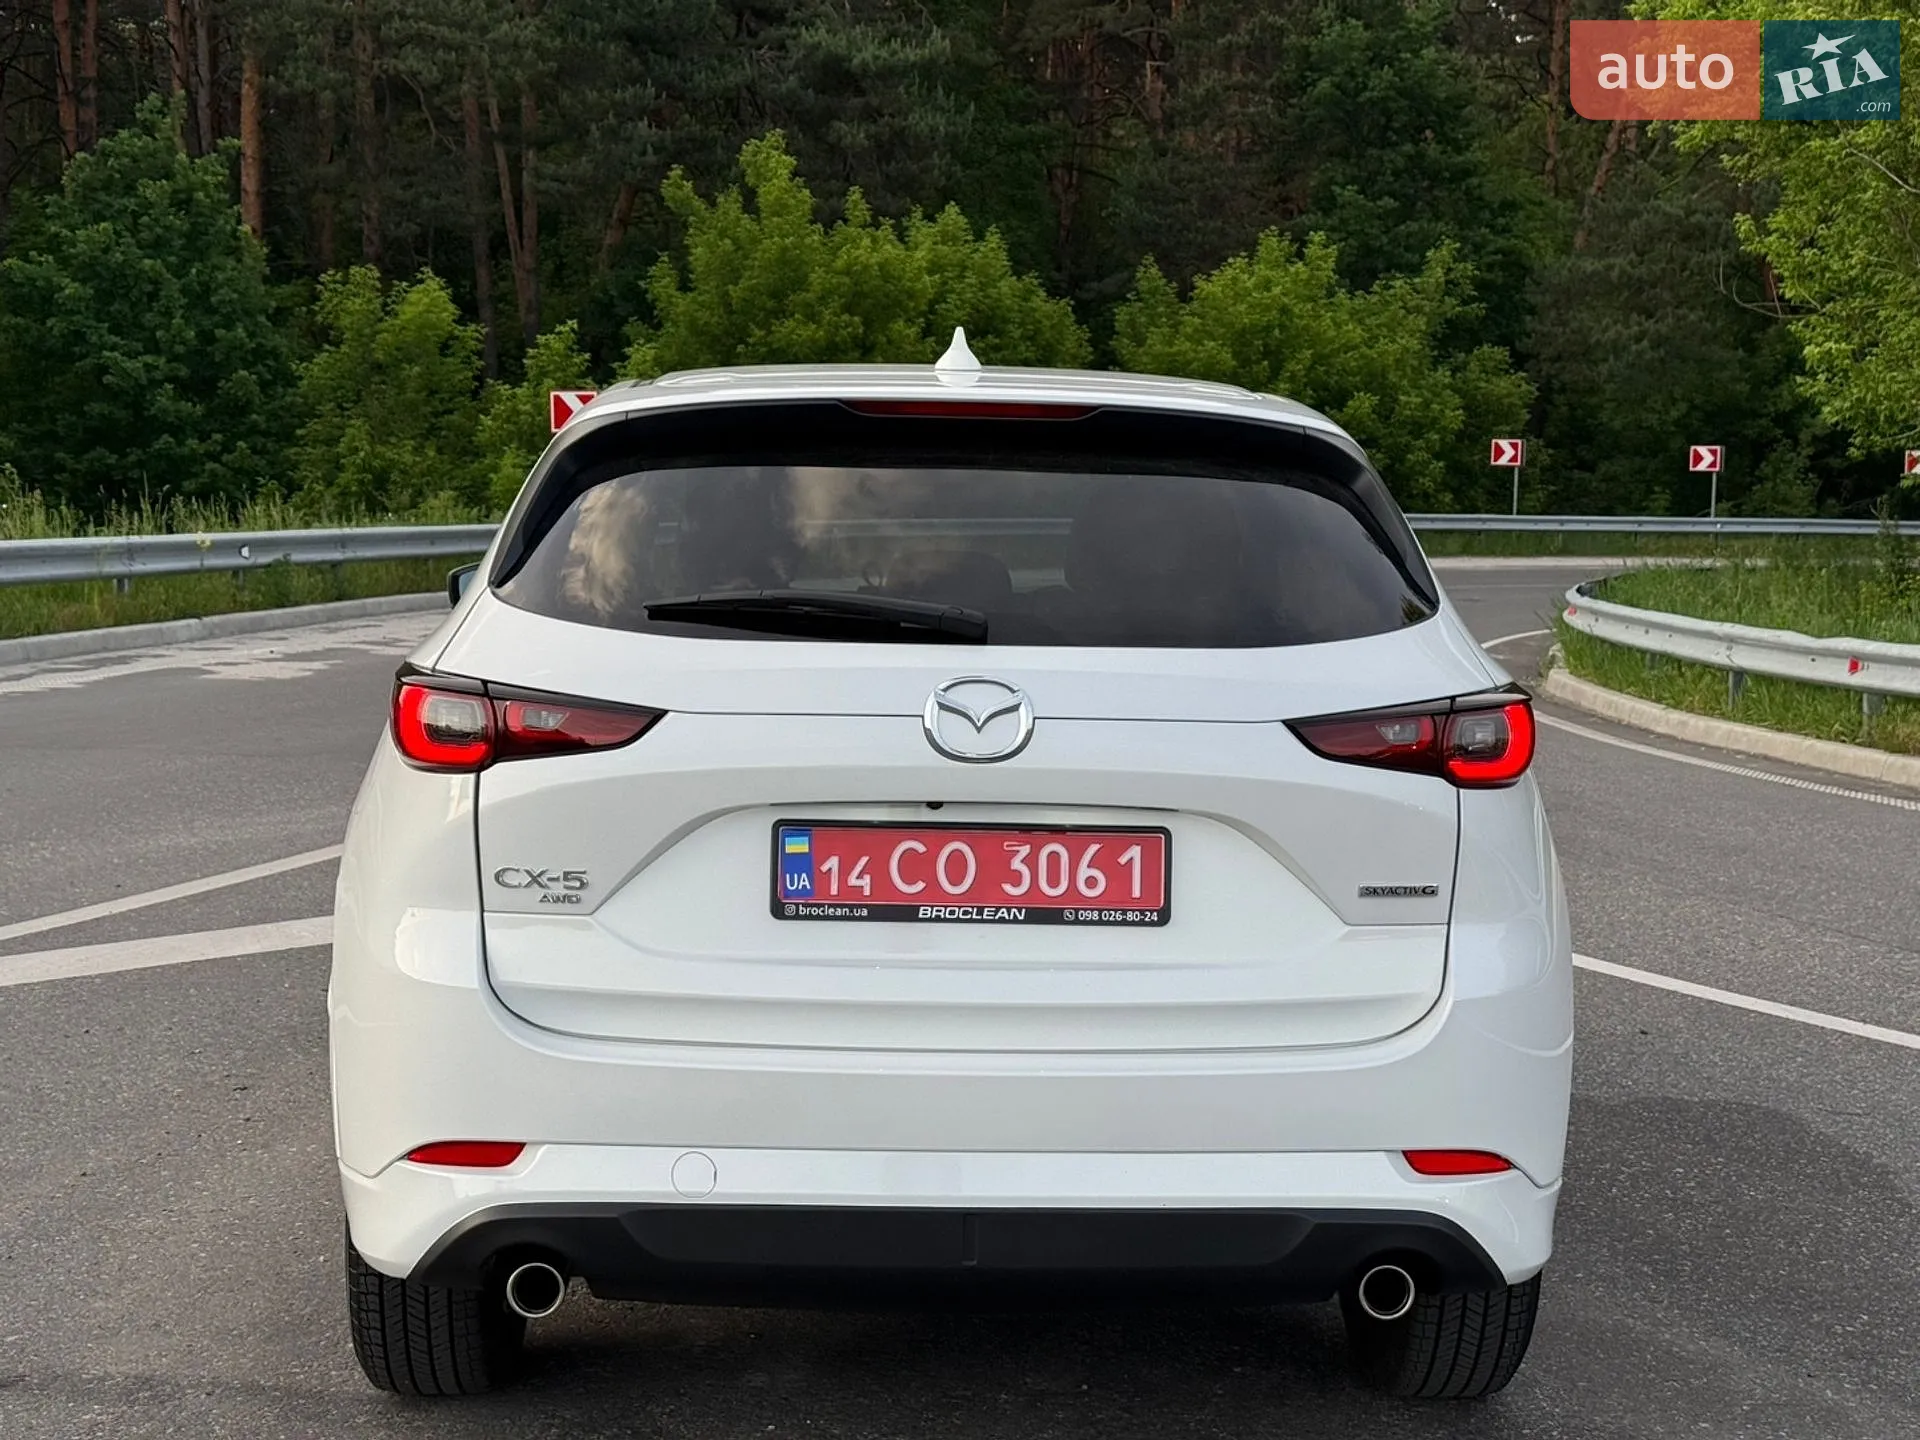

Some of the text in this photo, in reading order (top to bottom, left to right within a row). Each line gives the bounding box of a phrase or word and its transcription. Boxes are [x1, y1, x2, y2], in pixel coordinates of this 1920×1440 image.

[819, 839, 1143, 899] 14 CO 3061
[494, 867, 589, 890] CX-5
[786, 872, 811, 890] UA
[538, 892, 582, 904] AWD
[799, 904, 868, 917] broclean.ua
[918, 906, 1026, 921] BROCLEAN
[1078, 910, 1158, 922] 098 026-80-24
